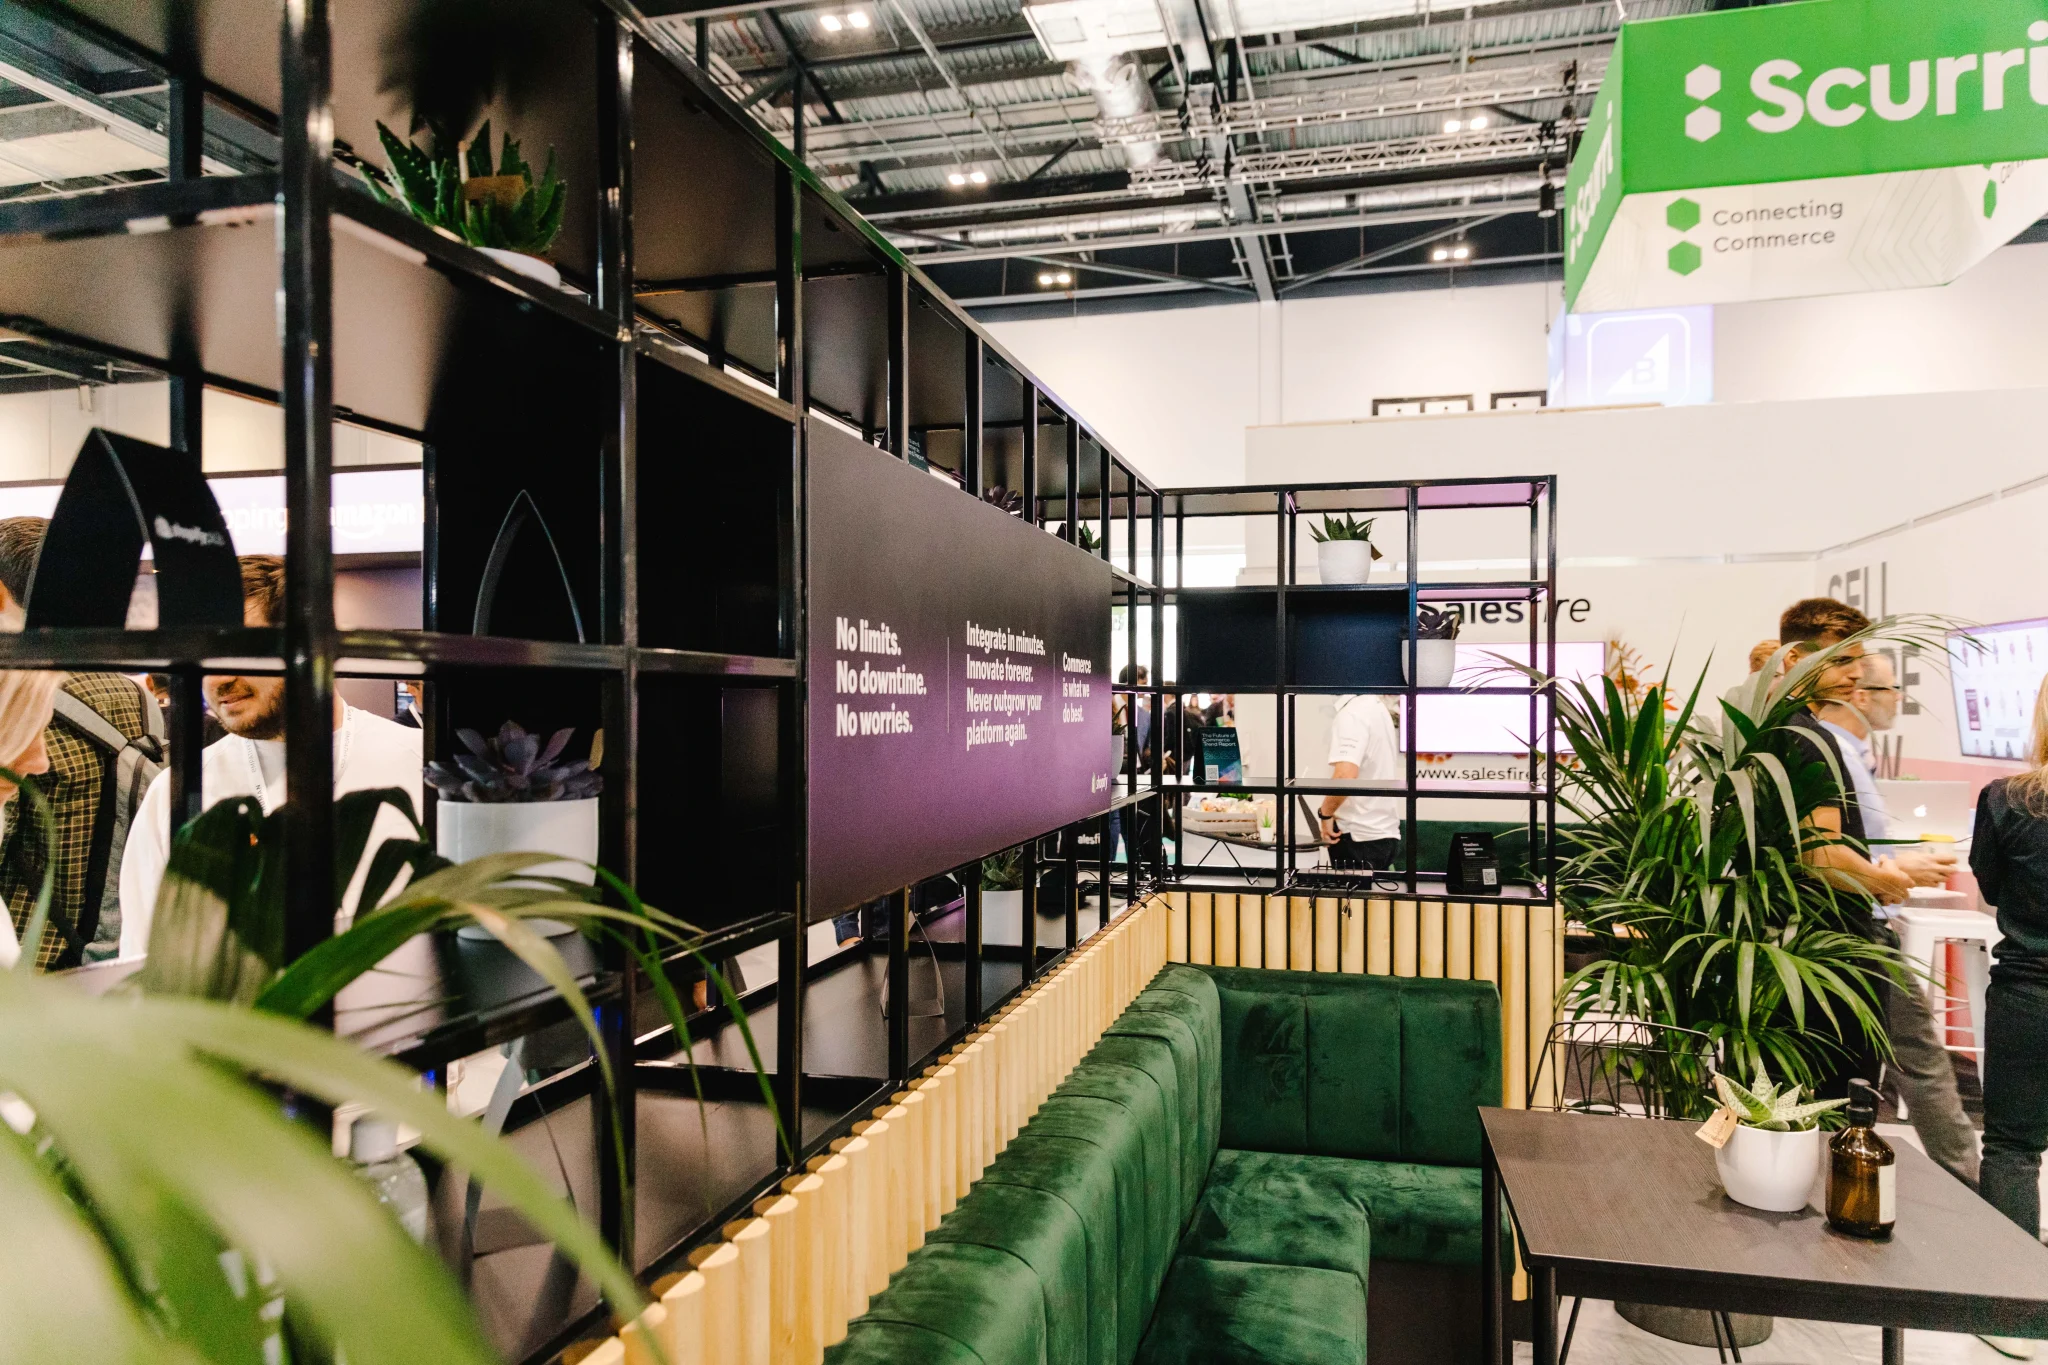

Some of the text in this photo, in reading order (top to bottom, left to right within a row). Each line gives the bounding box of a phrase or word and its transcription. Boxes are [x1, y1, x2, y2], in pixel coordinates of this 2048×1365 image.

[1746, 19, 2048, 134] Scurri
[1713, 199, 1843, 226] Connecting
[1713, 230, 1836, 253] Commerce
[331, 502, 417, 528] mazon
[836, 616, 902, 656] No limits.
[966, 620, 1046, 656] Integrate in minutes.
[836, 660, 927, 695] No downtime.
[966, 653, 1034, 683] Innovate forever.
[1062, 651, 1092, 674] Commerce
[966, 687, 1042, 717] Never outgrow your
[1062, 677, 1090, 698] is what we
[836, 702, 913, 737] No worries.
[1062, 702, 1084, 723] do best.
[966, 718, 1028, 752] platform again.
[1077, 833, 1101, 845] alesfi
